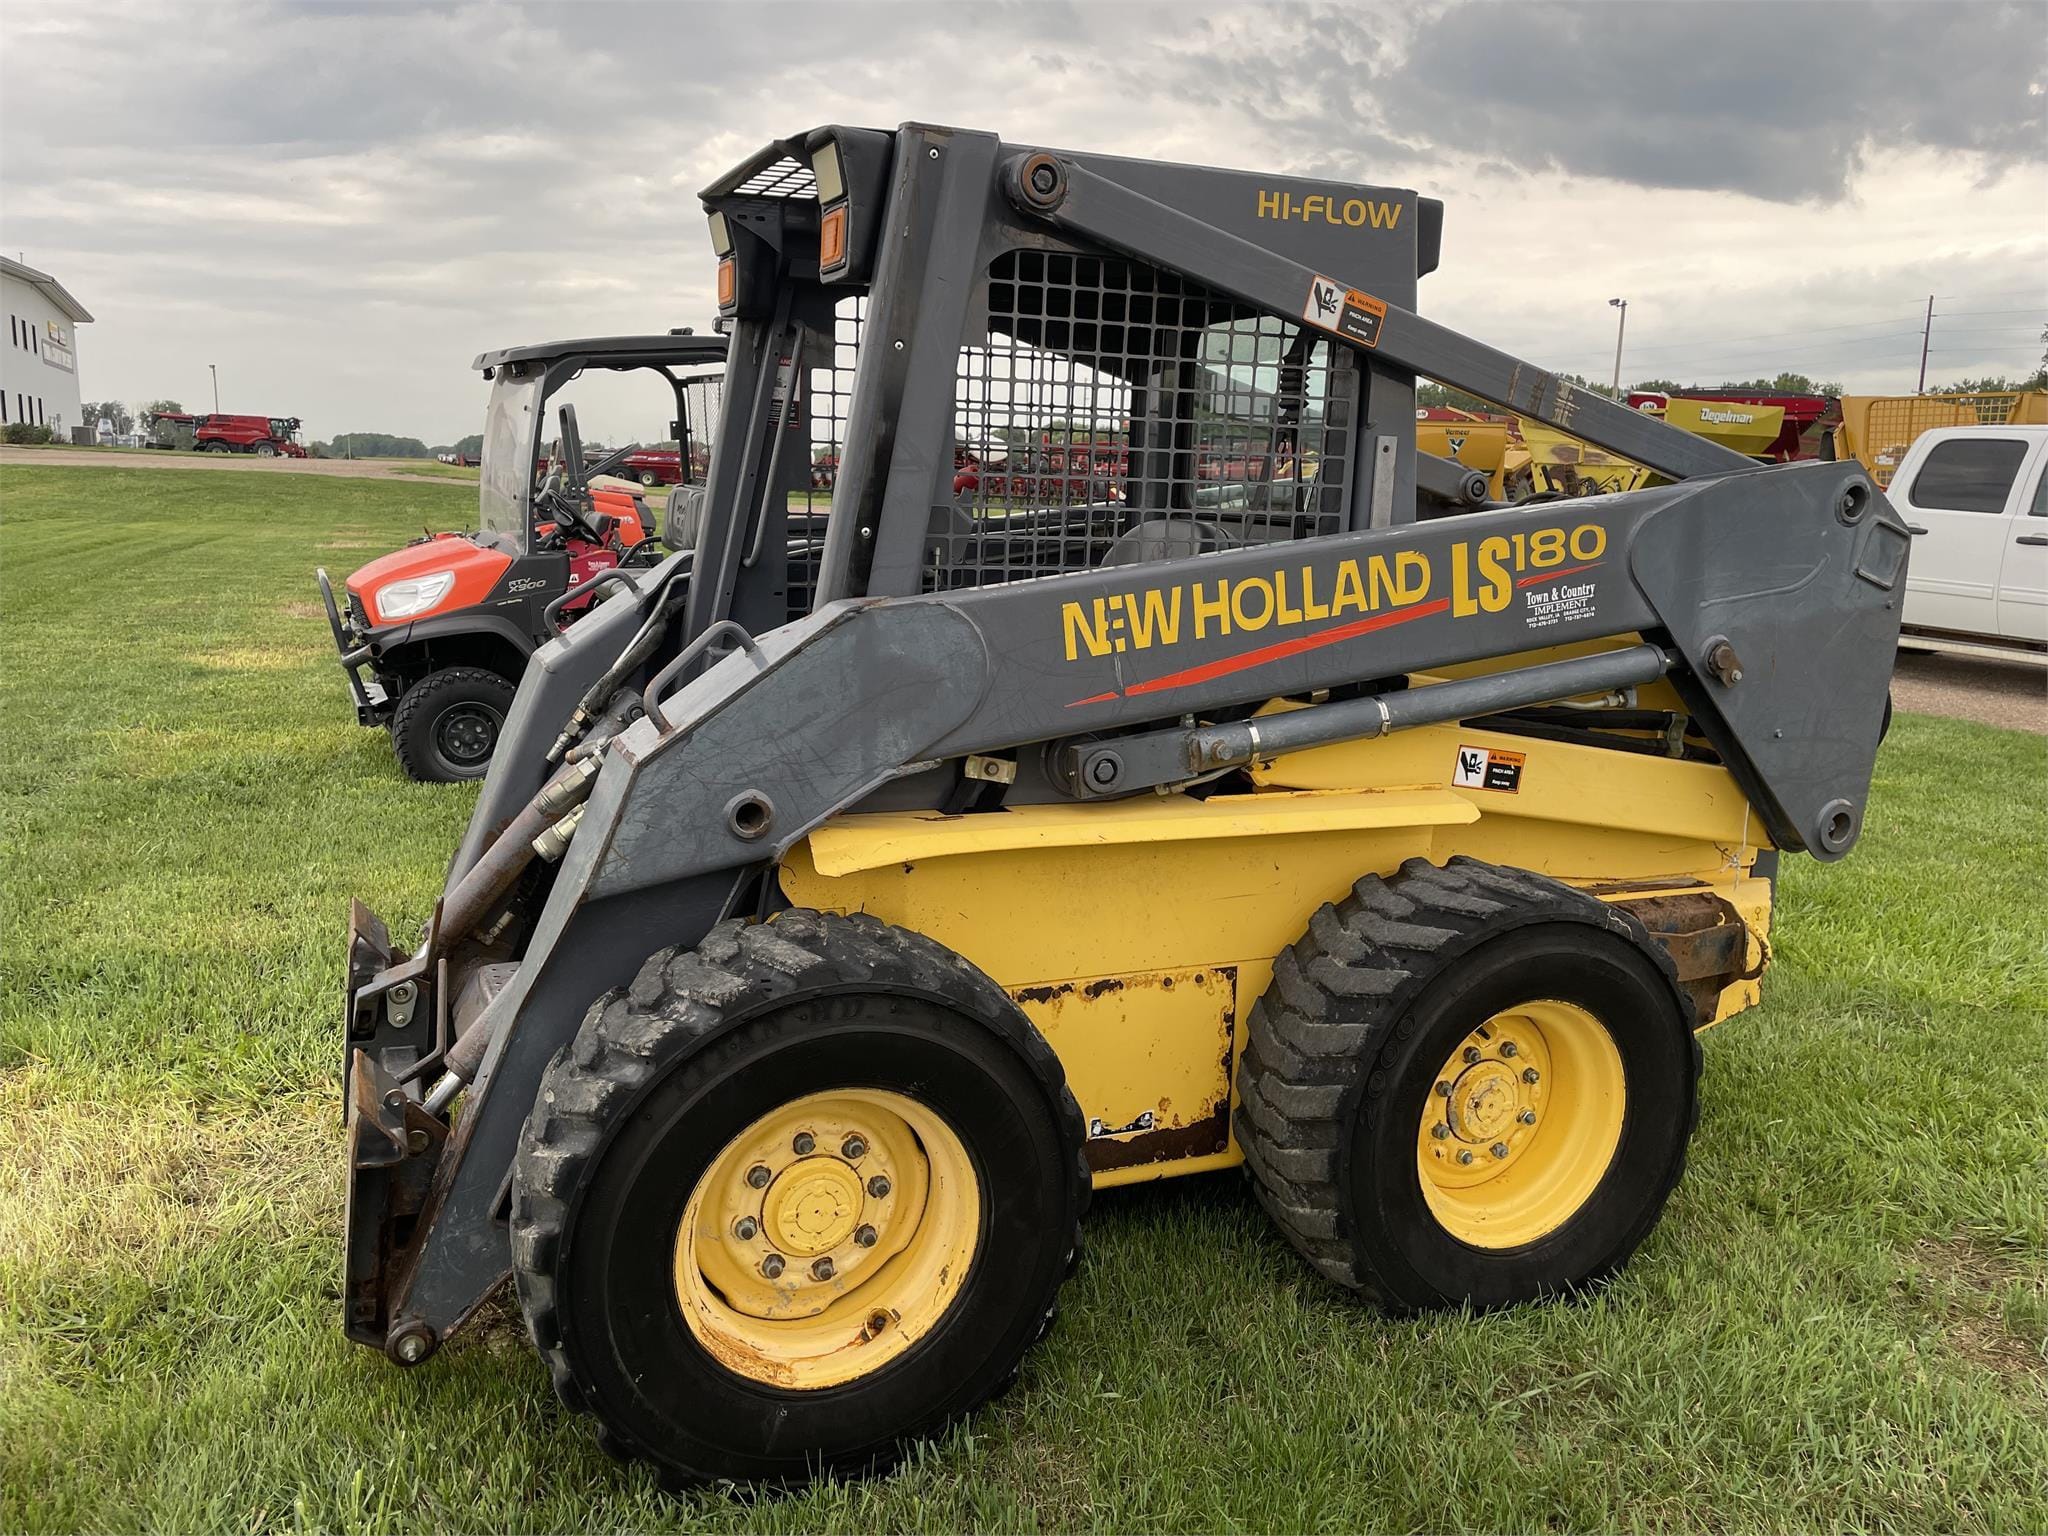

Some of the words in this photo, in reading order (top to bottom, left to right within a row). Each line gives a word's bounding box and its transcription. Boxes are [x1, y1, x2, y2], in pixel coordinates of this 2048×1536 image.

[1257, 190, 1403, 230] HI-FLOW
[1357, 299, 1382, 313] WARNING
[1362, 316, 1373, 325] AREA
[1700, 407, 1753, 425] Degelman
[508, 577, 532, 586] RTV
[508, 580, 547, 594] X900
[1526, 592, 1549, 605] Town
[1551, 588, 1560, 601] &
[1561, 584, 1596, 599] Country
[1062, 585, 1182, 661] NEW
[1193, 550, 1432, 640] HOLLAND
[1534, 598, 1588, 616] IMPLEMENT
